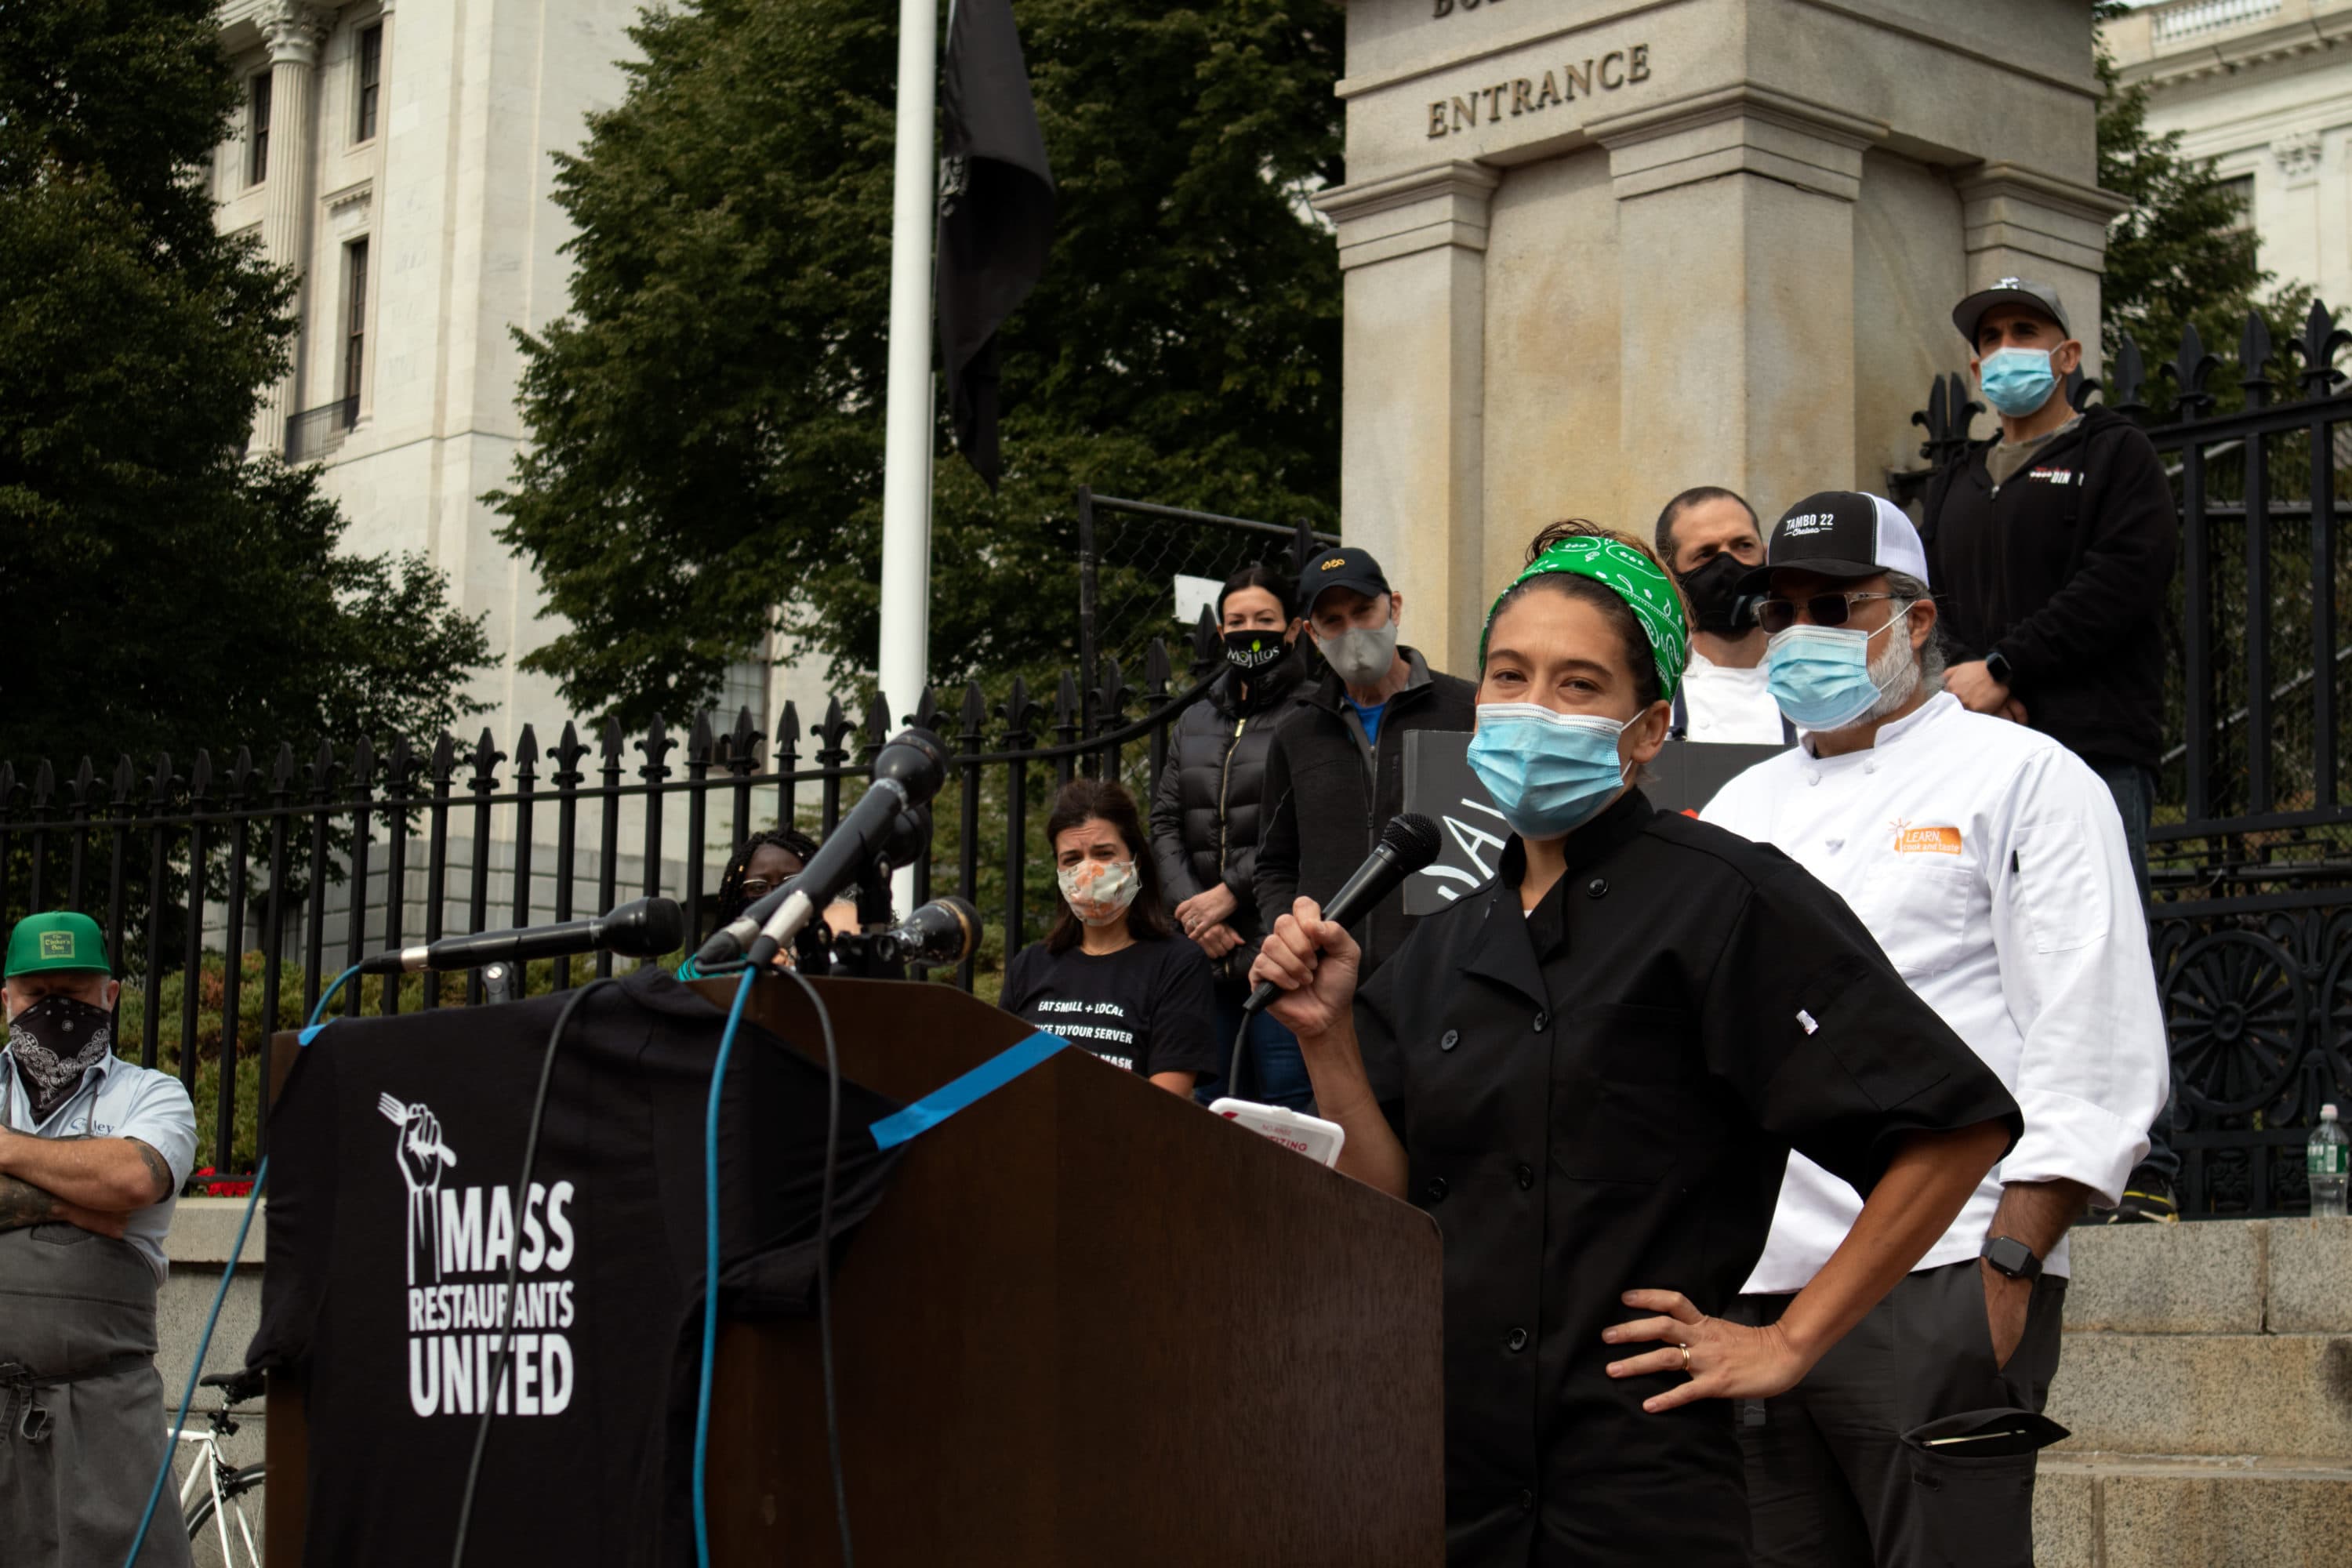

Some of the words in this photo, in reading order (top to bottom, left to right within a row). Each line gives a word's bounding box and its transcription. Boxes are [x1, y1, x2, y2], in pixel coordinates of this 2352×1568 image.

[1426, 43, 1650, 139] ENTRANCE
[1786, 514, 1817, 531] TAMBO
[1820, 514, 1834, 525] 22
[1227, 646, 1280, 669] Mojitos
[1038, 1000, 1054, 1011] EAT
[1094, 1003, 1124, 1018] LOCAL
[1054, 1025, 1066, 1036] TO
[1066, 1025, 1094, 1037] YOUR
[1094, 1028, 1134, 1044] SERVER
[441, 1181, 575, 1273] MASS
[408, 1279, 574, 1332] RESTAURANTS
[409, 1334, 574, 1417] UNITED
